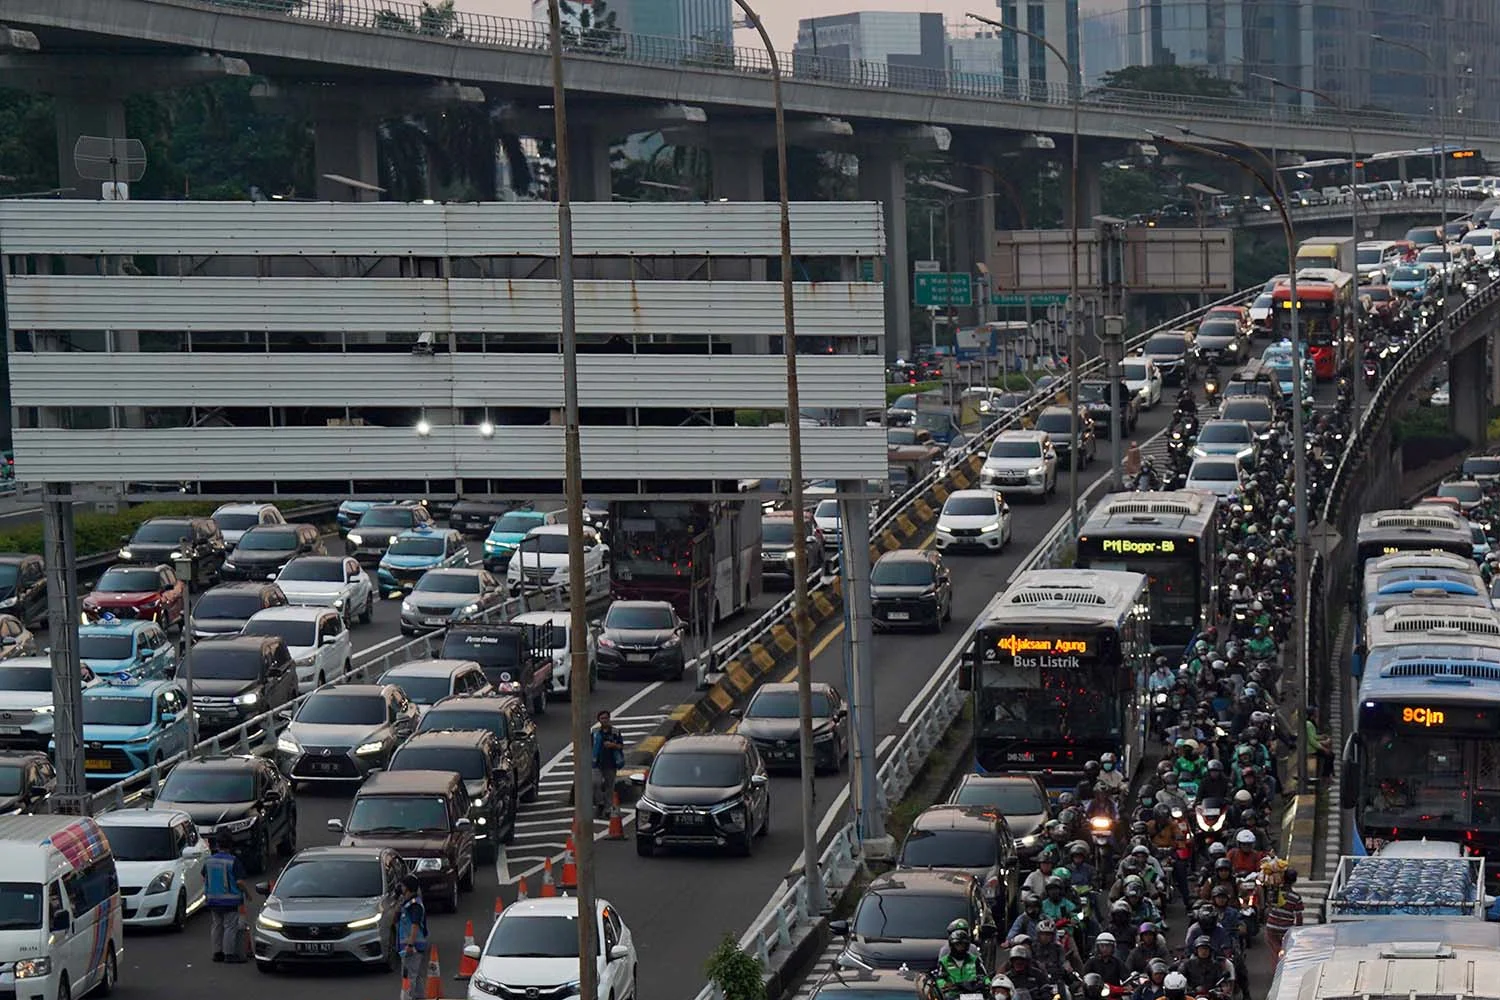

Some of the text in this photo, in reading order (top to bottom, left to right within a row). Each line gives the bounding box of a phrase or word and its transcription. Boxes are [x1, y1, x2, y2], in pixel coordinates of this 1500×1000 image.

[1055, 639, 1086, 653] Agung
[1013, 655, 1080, 668] Bus Listrik
